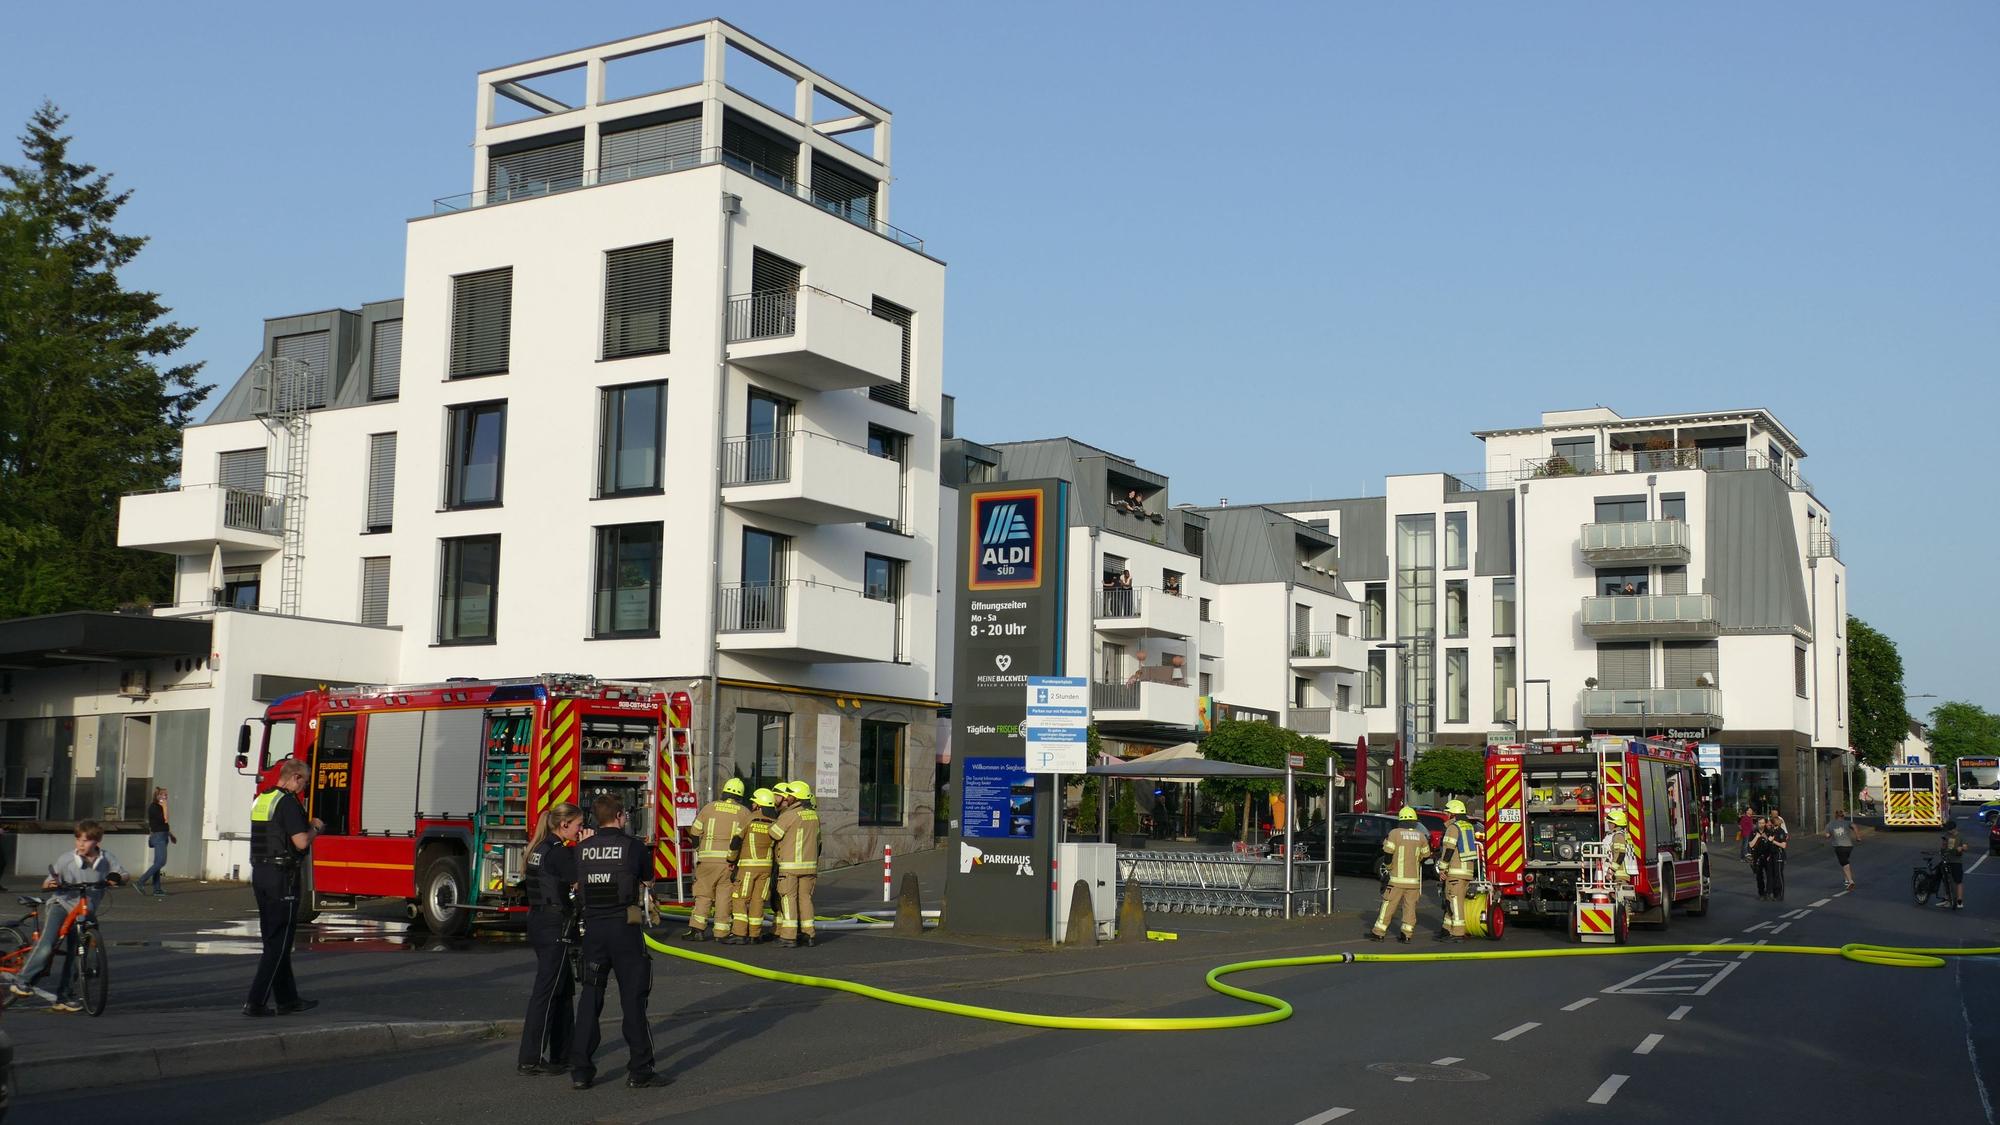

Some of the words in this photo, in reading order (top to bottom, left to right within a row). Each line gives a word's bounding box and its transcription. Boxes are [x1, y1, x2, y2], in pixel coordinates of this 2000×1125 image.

[982, 546, 1030, 565] ALDI
[997, 565, 1015, 575] SÜD
[971, 601, 1027, 611] Öffnungszeiten
[971, 614, 982, 622] Mo
[970, 625, 978, 636] 8
[988, 624, 1002, 636] 20
[1005, 623, 1027, 635] Uhr
[967, 725, 996, 735] Tägliche
[996, 725, 1018, 733] FRISCHE
[1668, 728, 1705, 739] Stenzel
[328, 771, 348, 788] 112
[582, 846, 622, 860] POLIZEI
[983, 854, 1031, 865] PARKHAUS
[587, 873, 611, 884] NRW
